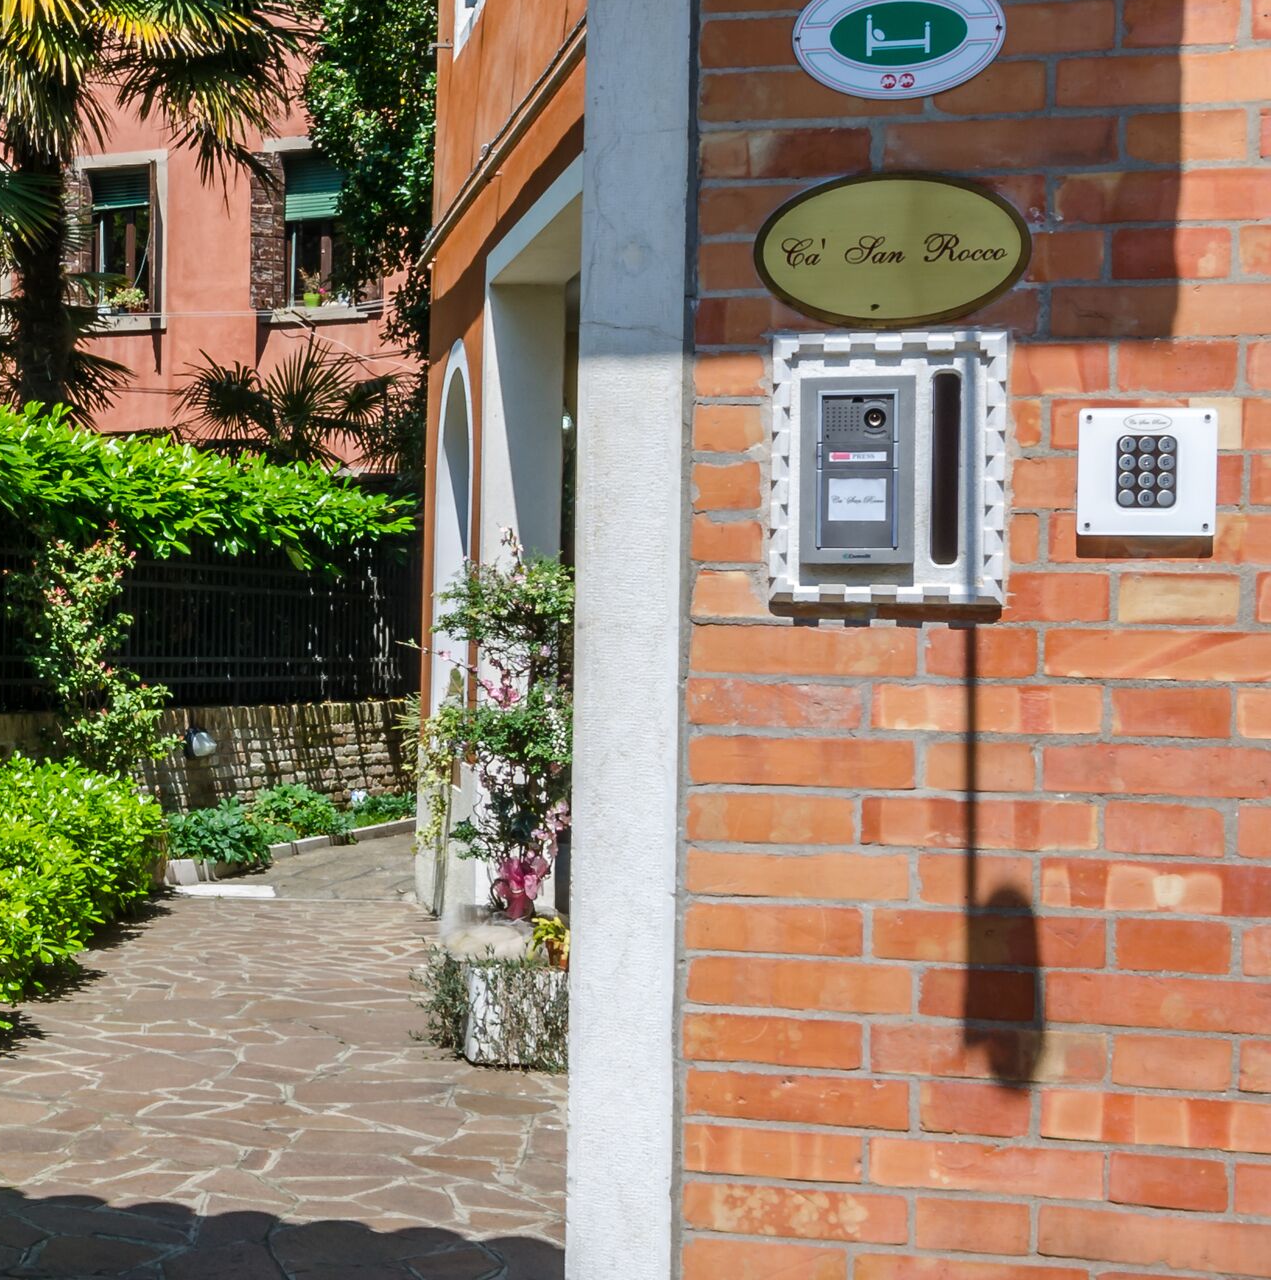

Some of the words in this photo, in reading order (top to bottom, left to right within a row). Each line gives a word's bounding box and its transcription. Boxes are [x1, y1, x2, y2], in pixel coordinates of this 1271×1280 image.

[781, 237, 826, 269] Ca'
[844, 235, 906, 265] San
[923, 232, 1008, 263] Rocco
